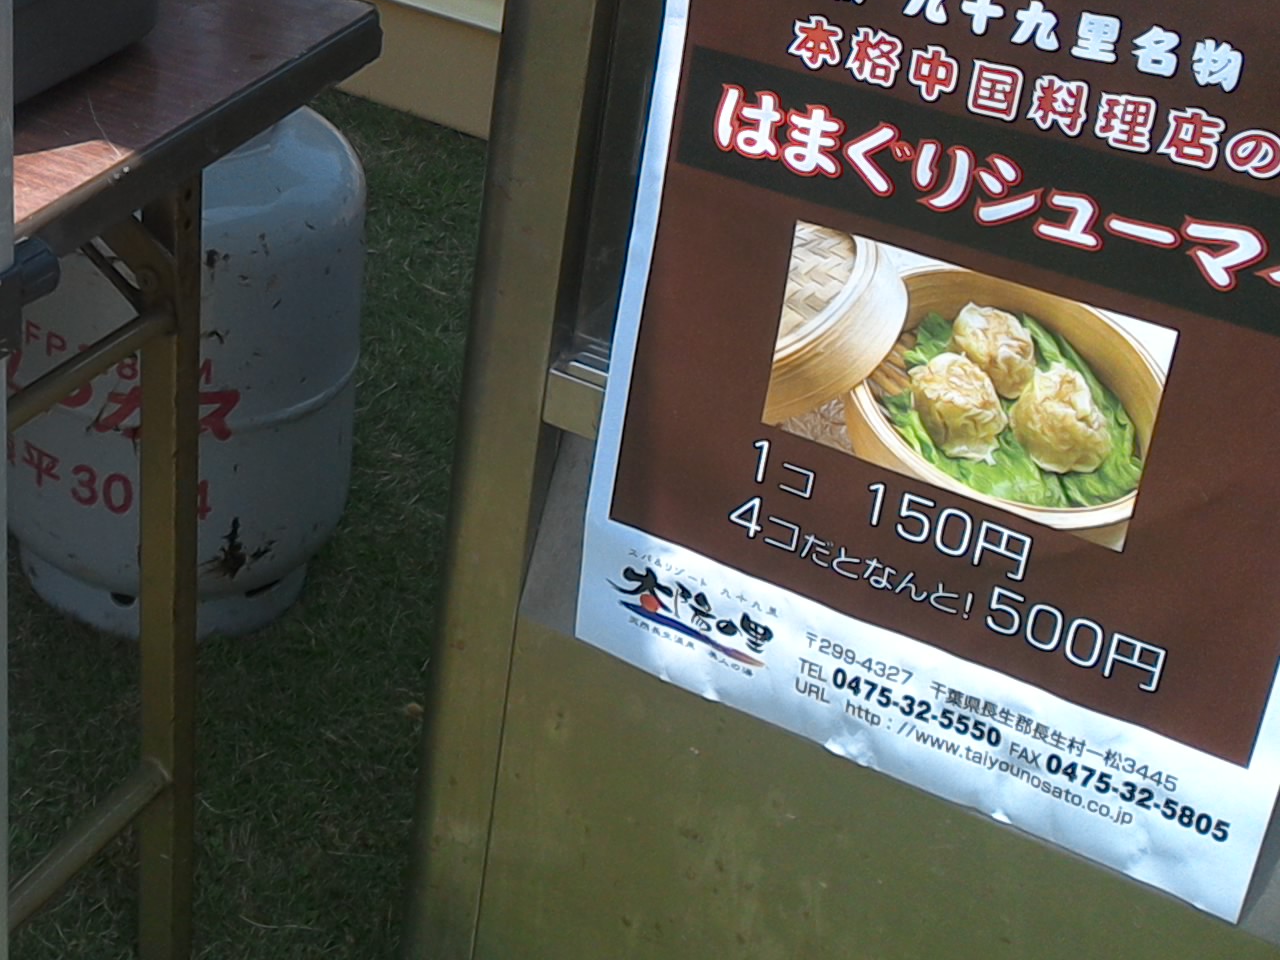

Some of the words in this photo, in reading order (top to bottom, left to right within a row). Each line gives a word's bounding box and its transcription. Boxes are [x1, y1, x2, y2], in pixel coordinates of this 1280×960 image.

[789, 15, 1280, 179] 本格中国料理店の
[715, 84, 1280, 291] はまぐりシューマ
[753, 441, 815, 499] 1コ
[867, 483, 1032, 581] 150円
[795, 677, 831, 705] URL
[799, 657, 828, 683] TEL
[832, 667, 1002, 748] 0475-32-5550
[1009, 741, 1041, 769] FAX
[1045, 753, 1231, 843] 0475-32-5805
